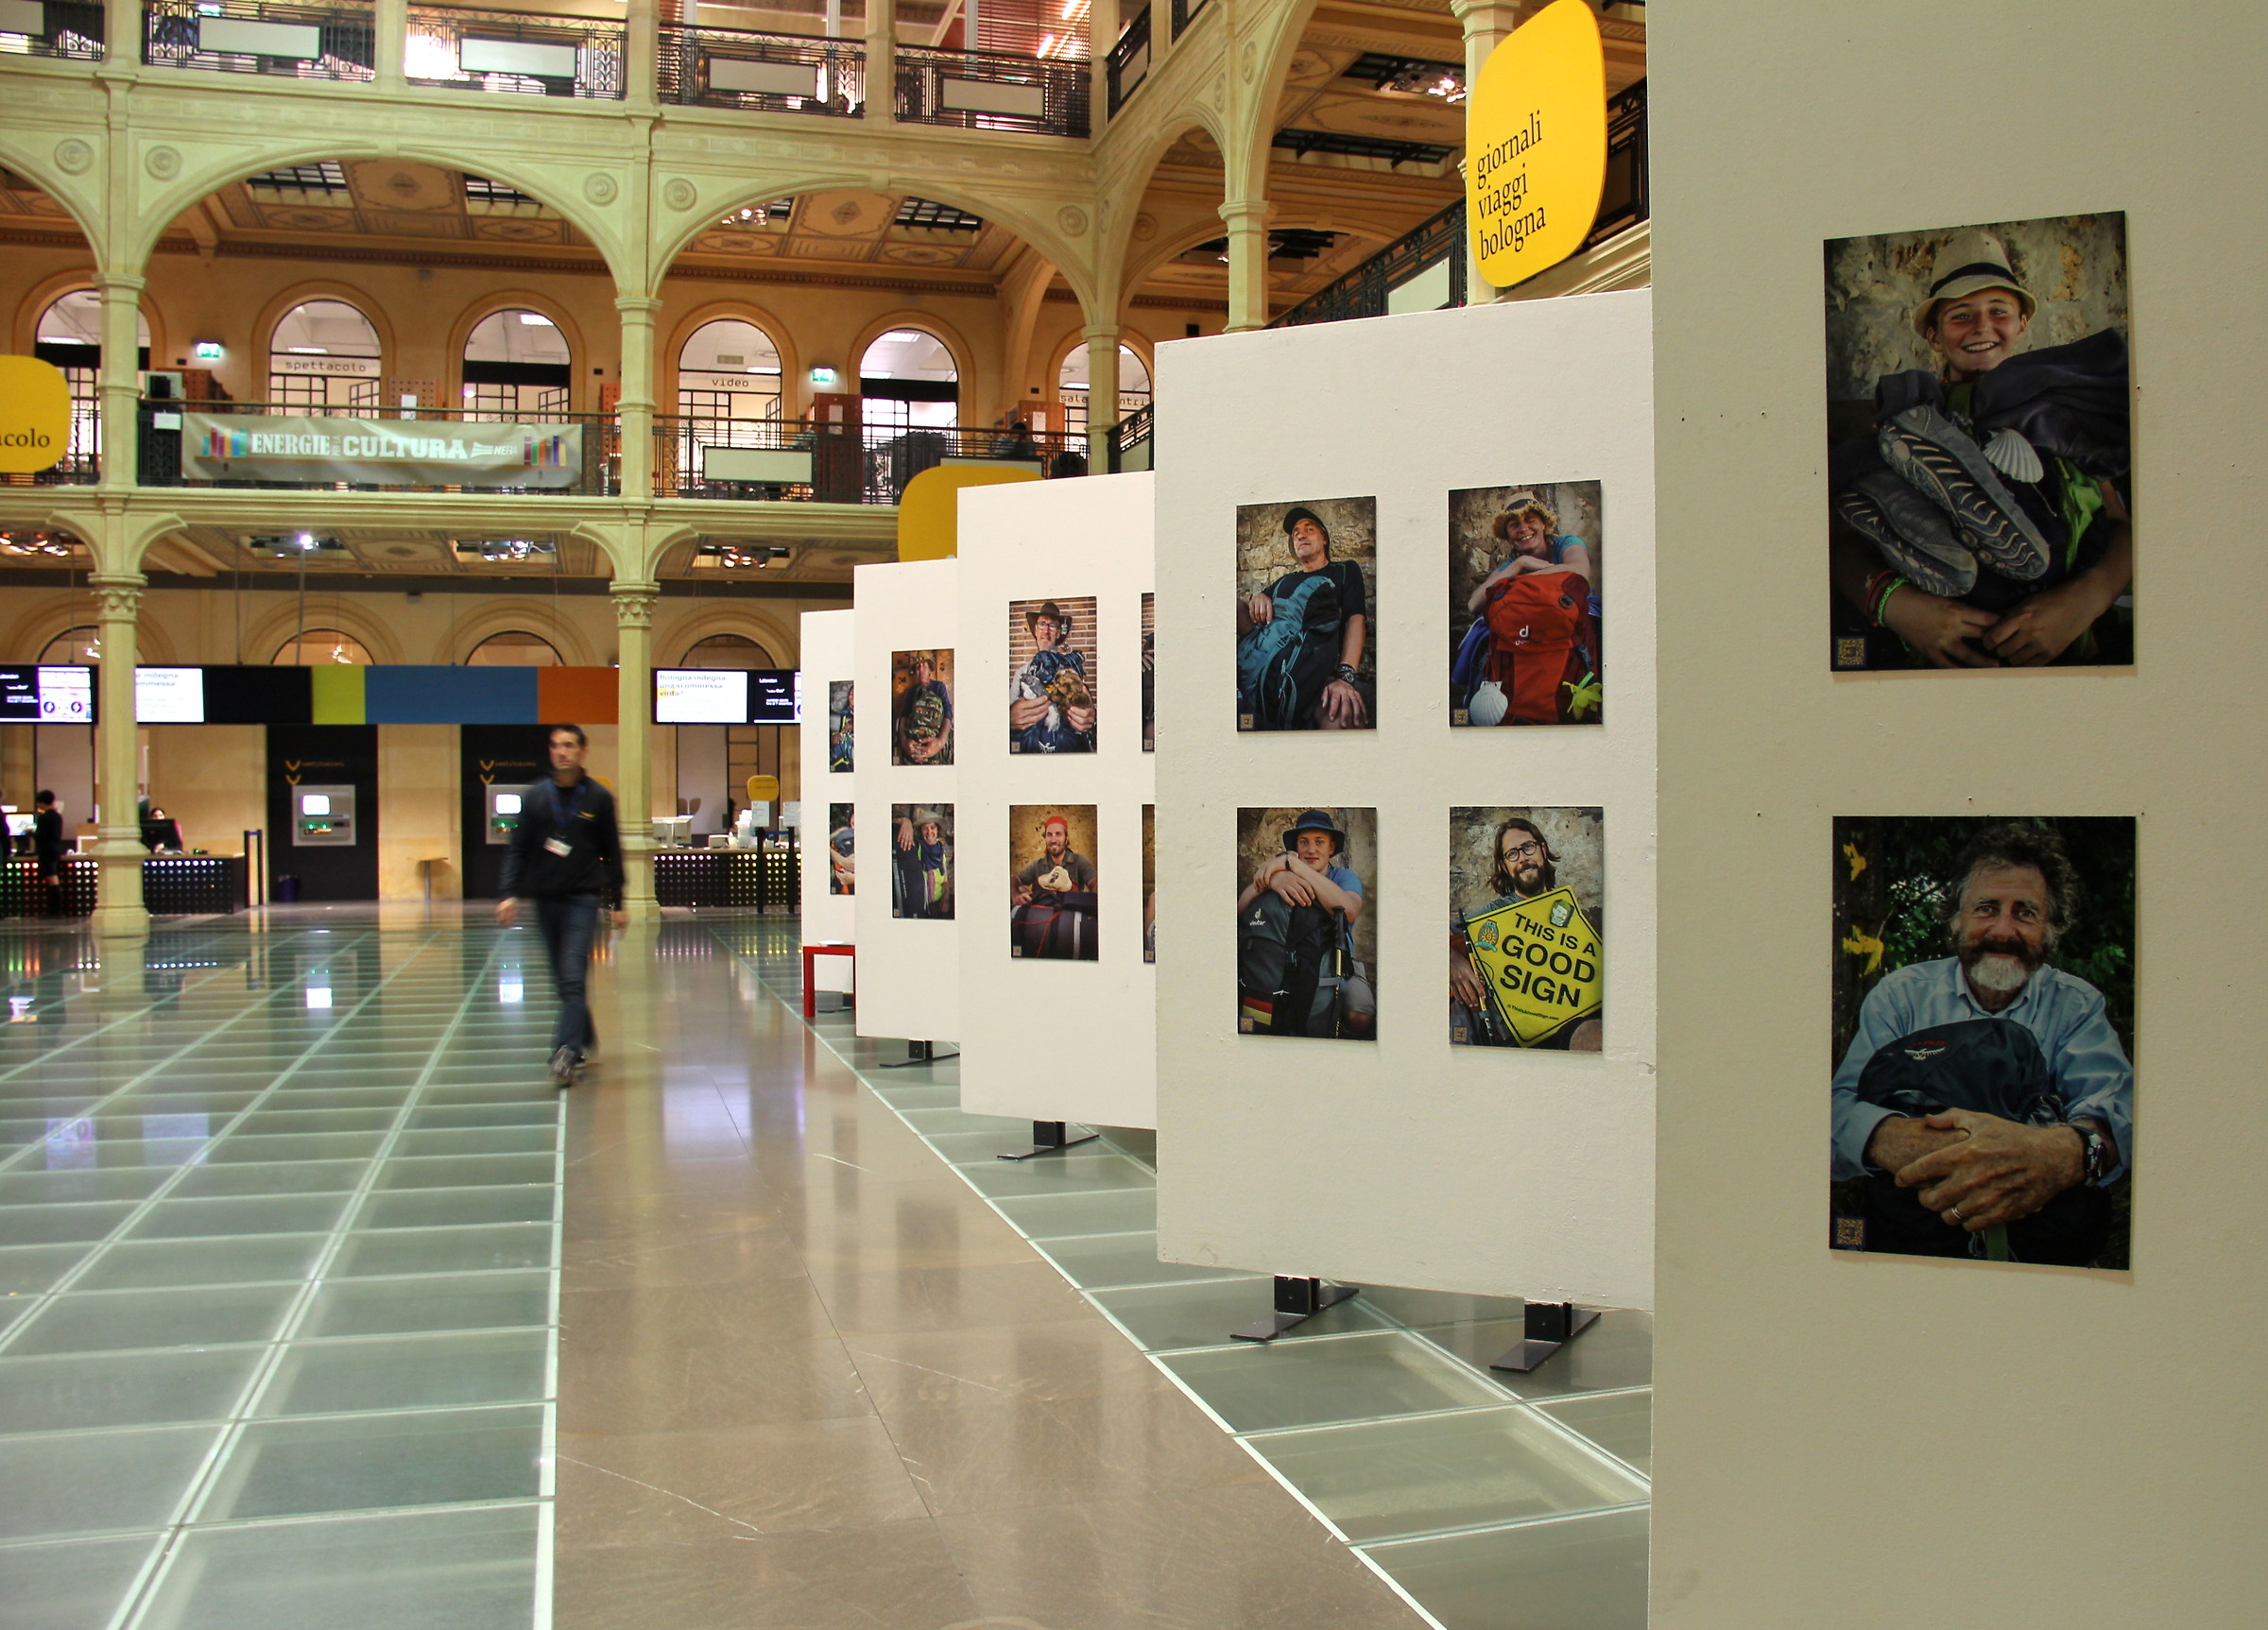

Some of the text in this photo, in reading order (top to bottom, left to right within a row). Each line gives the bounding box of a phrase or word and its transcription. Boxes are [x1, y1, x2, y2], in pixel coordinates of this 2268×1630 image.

[1477, 110, 1542, 189] giornali
[1478, 163, 1528, 219] viaggi
[1479, 206, 1547, 261] bologna
[285, 360, 366, 372] spettacolo
[712, 378, 749, 387] video
[1060, 394, 1089, 403] sala
[0, 428, 50, 448] colo
[251, 433, 330, 455] ENERGIE
[342, 436, 468, 460] CULTURA
[1515, 912, 1596, 957] THIS IS A
[1502, 935, 1595, 983] GOOD
[1500, 964, 1581, 1008] SIGN
